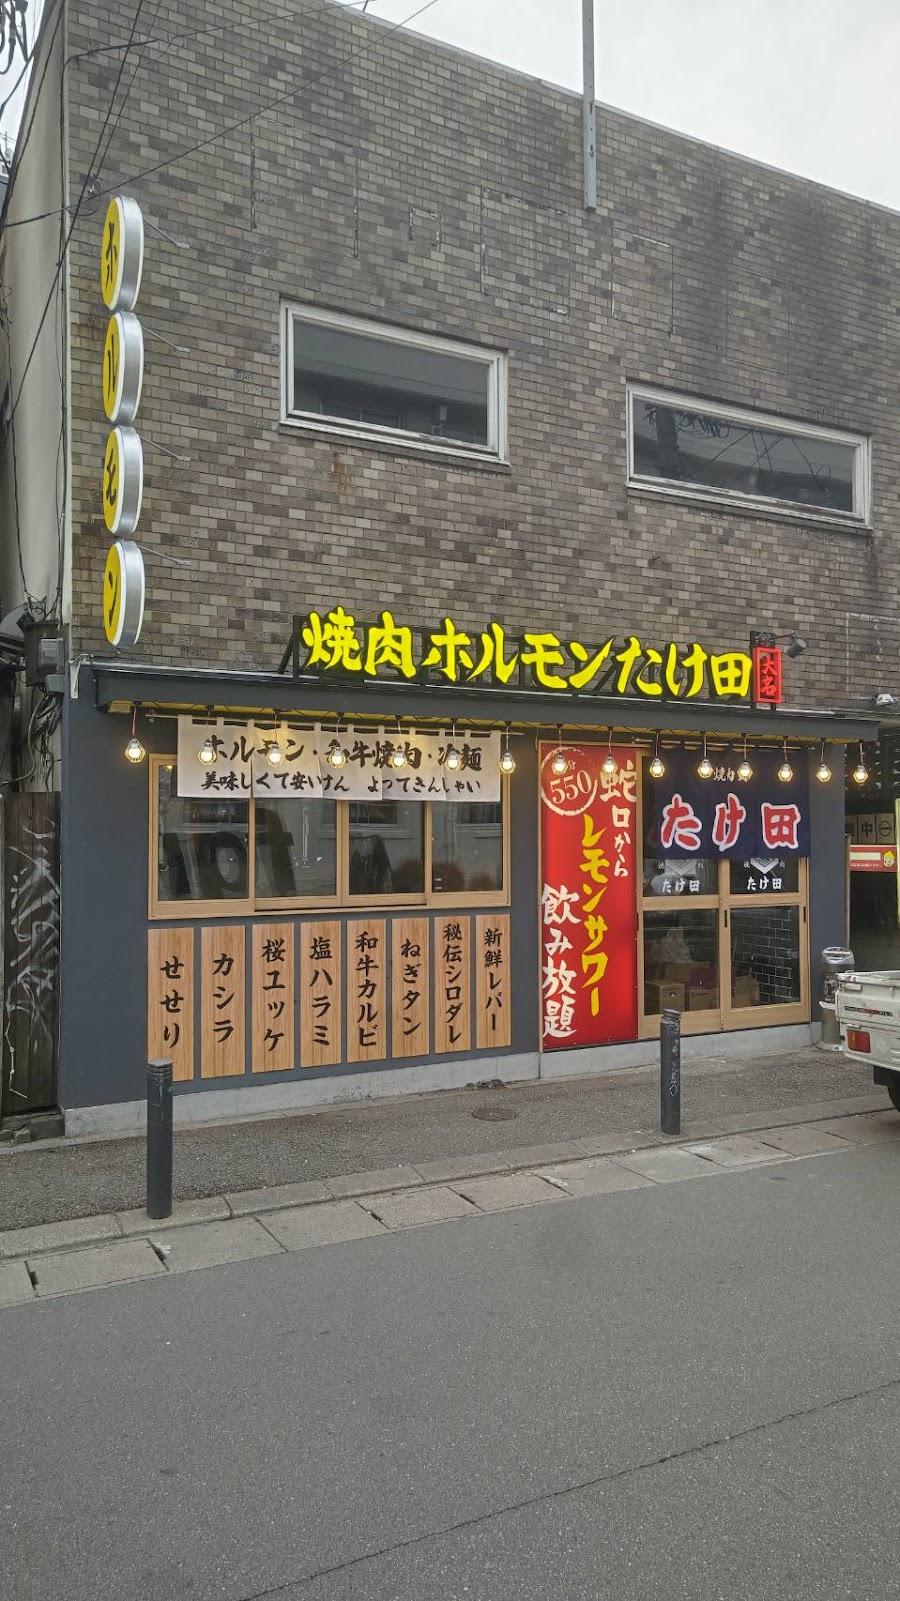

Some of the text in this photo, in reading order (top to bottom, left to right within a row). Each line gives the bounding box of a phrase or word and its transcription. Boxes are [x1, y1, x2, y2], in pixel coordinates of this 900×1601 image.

[761, 655, 778, 697] 大名
[549, 769, 592, 804] 550
[600, 759, 637, 878] 蛇口から
[660, 793, 802, 852] たけ田
[579, 813, 610, 1017] レモンサワー
[662, 878, 701, 893] たけ田
[747, 875, 783, 891] たけ田
[159, 955, 185, 1049] せせり
[211, 952, 235, 1043] カシラ
[261, 938, 286, 1052] 桜ユッケ
[309, 936, 334, 1047] 塩ハラミ
[354, 930, 380, 1047] 和牛カルビ
[400, 938, 422, 1036] ねぎタン
[442, 922, 464, 1045] 秘伝シロダレ
[483, 928, 503, 1031] 新鮮レバー
[542, 883, 582, 1038] 飲み放題
